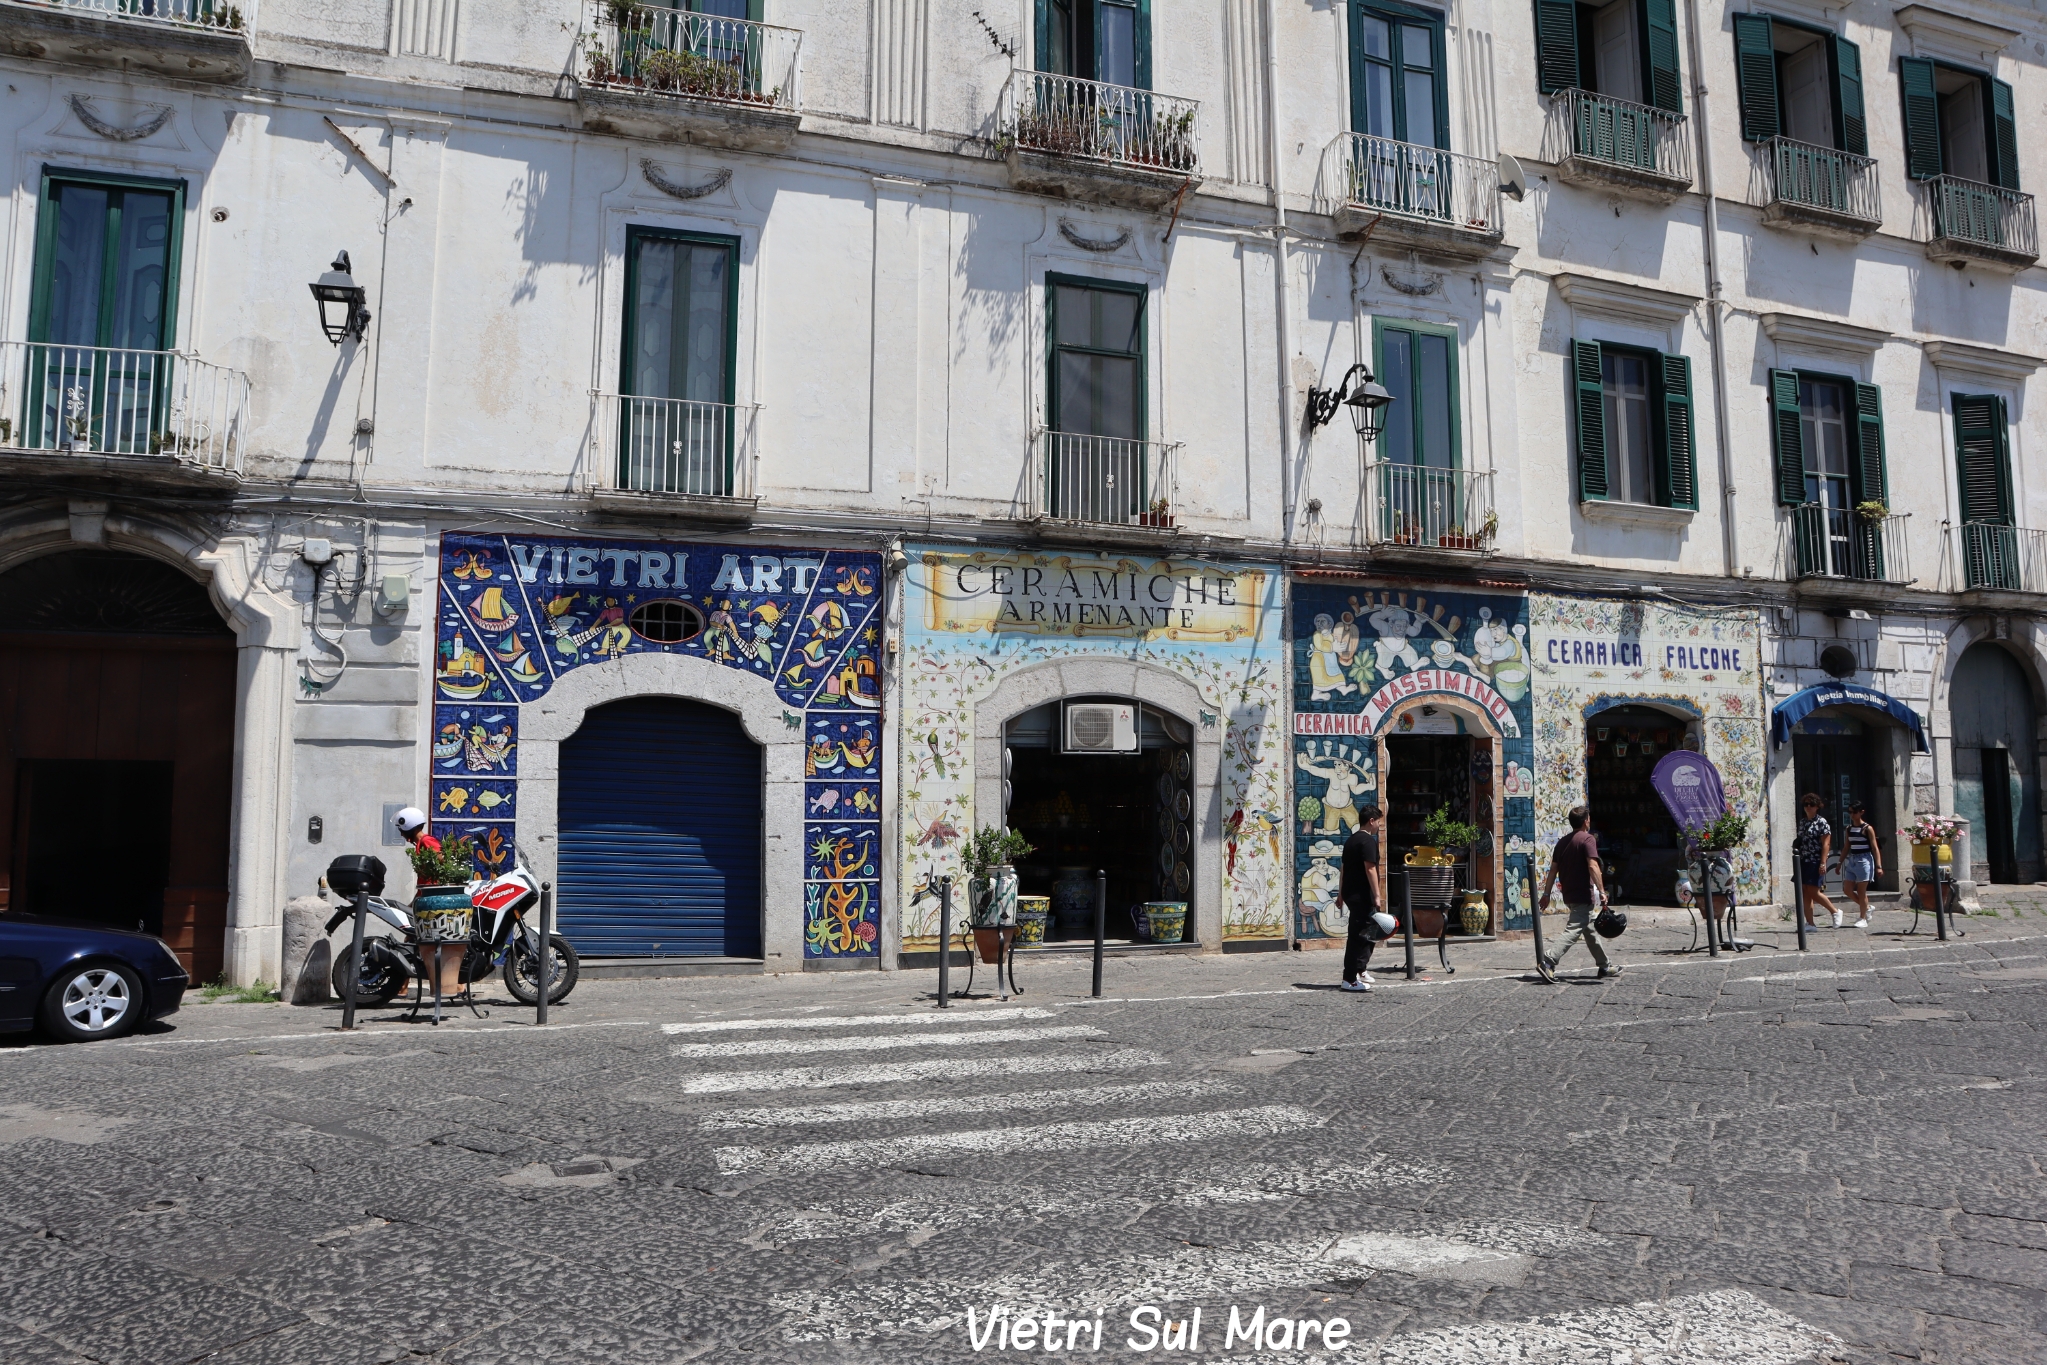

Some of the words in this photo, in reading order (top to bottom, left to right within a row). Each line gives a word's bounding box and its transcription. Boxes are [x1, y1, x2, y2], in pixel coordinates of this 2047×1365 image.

[510, 545, 690, 589] VIETRI
[711, 553, 821, 594] ART
[957, 564, 1237, 606] CERAMICHE
[1000, 600, 1193, 629] ARMENANTE
[1548, 639, 1643, 667] CERAMICA
[1666, 645, 1742, 672] FALCONE
[1296, 713, 1374, 735] CERAMICA
[1371, 669, 1509, 720] MASSIMINO
[1844, 689, 1888, 707] Immbiliare
[488, 887, 515, 901] MORINI
